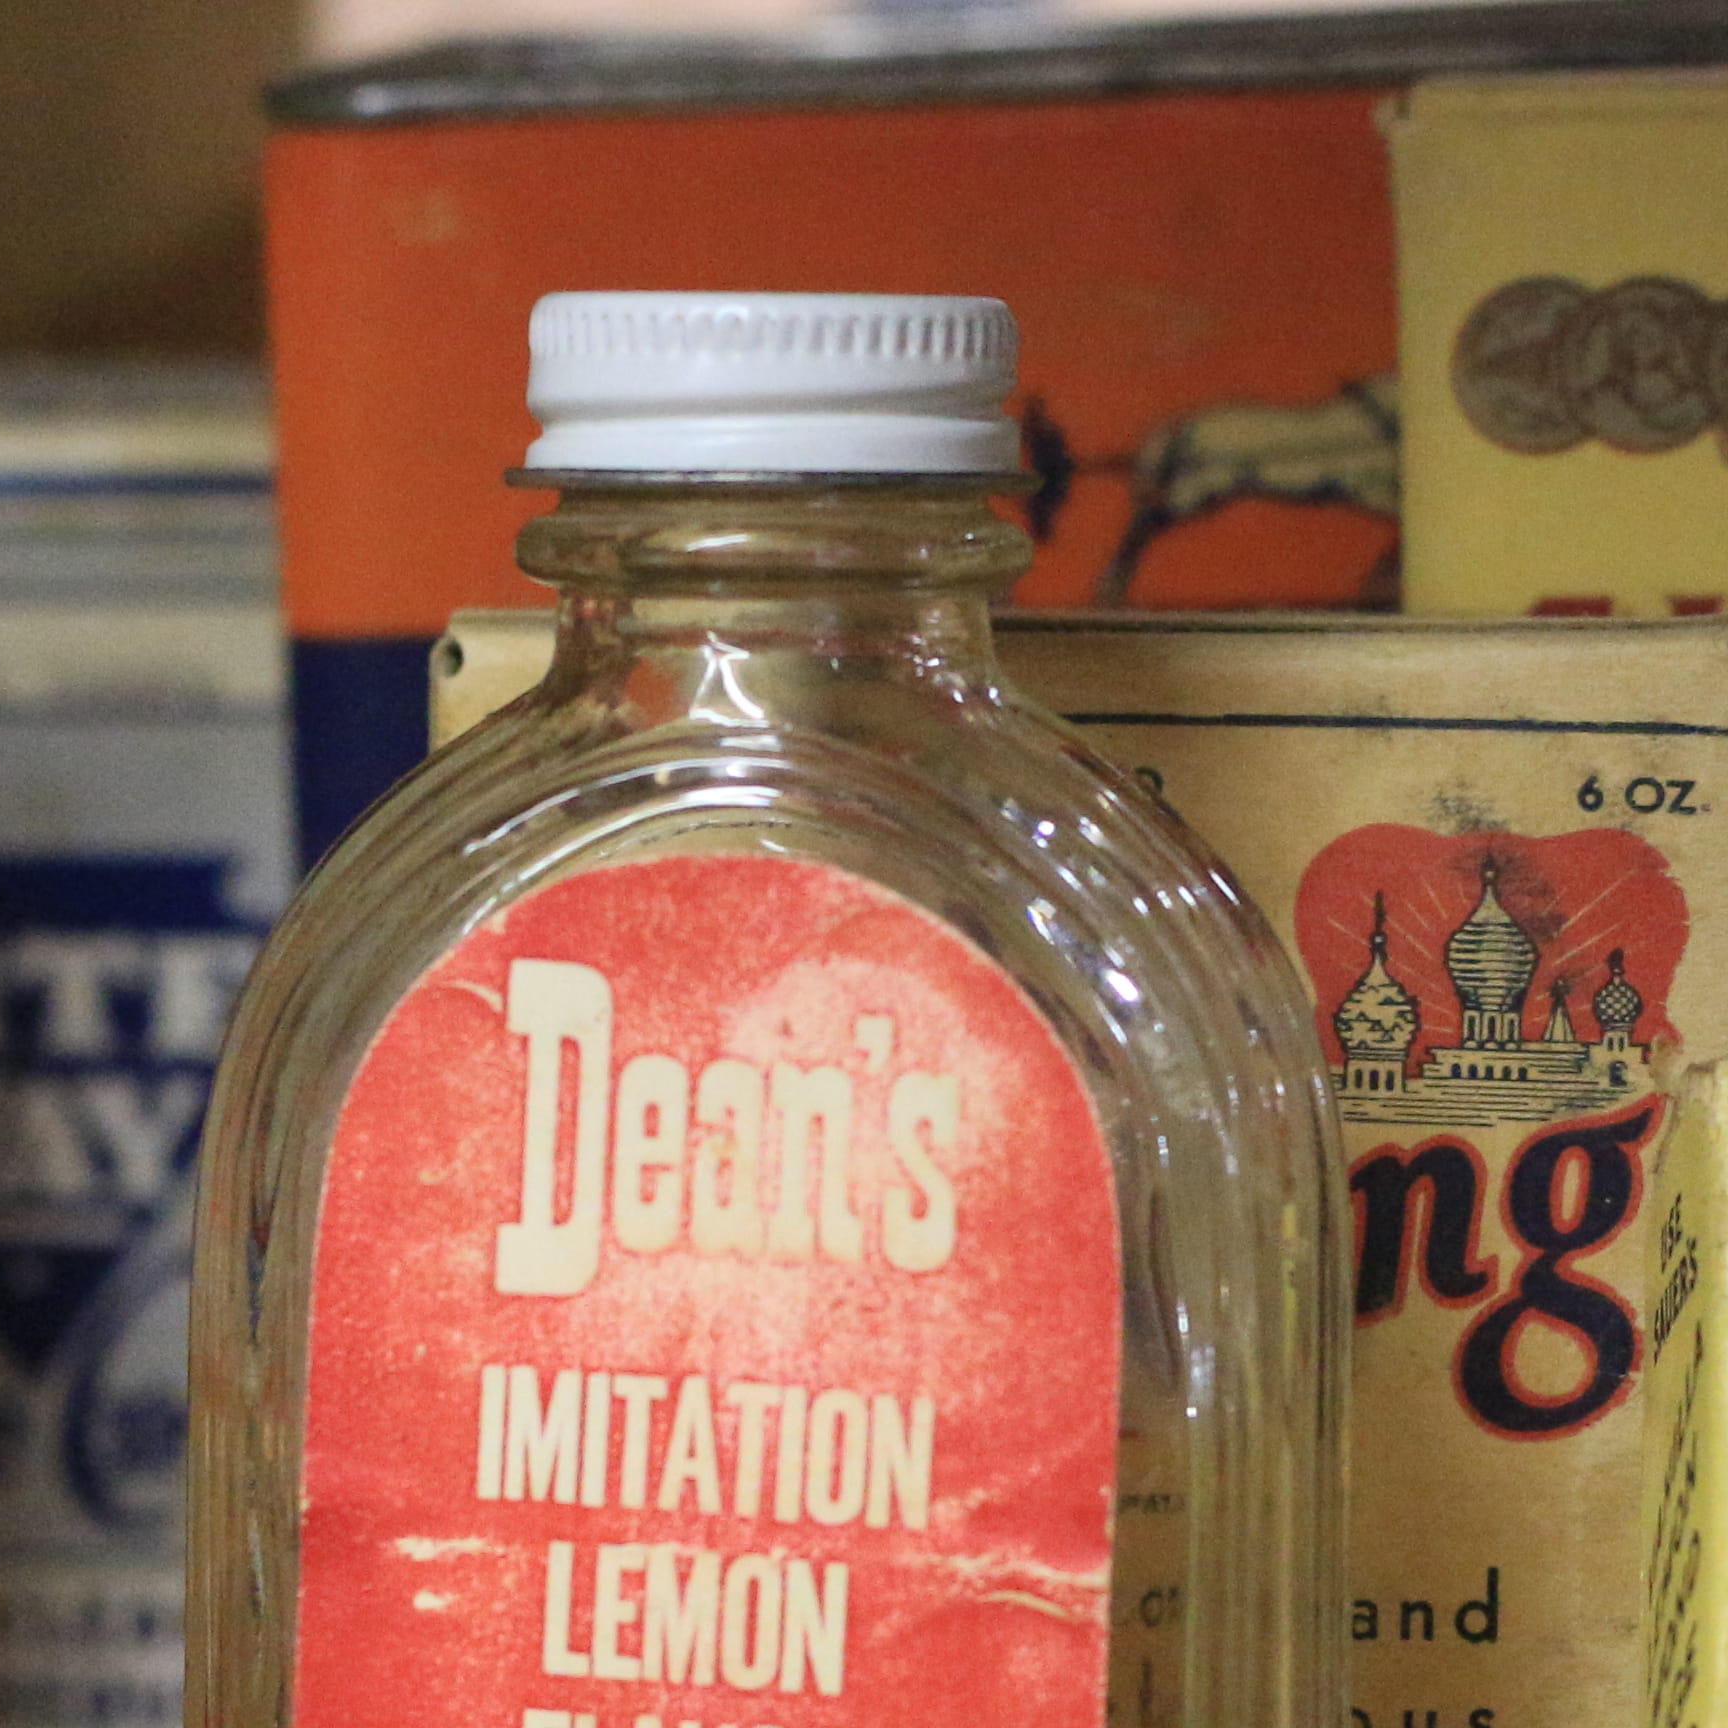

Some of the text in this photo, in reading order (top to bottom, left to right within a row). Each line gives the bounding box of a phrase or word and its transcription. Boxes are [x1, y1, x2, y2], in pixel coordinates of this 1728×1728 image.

[1577, 775, 1604, 813] 6
[494, 958, 960, 1296] Dean's
[1352, 1095, 1668, 1444] ng
[476, 1364, 936, 1532] IMITATION
[542, 1540, 849, 1697] LEMON
[1353, 1567, 1499, 1643] and
